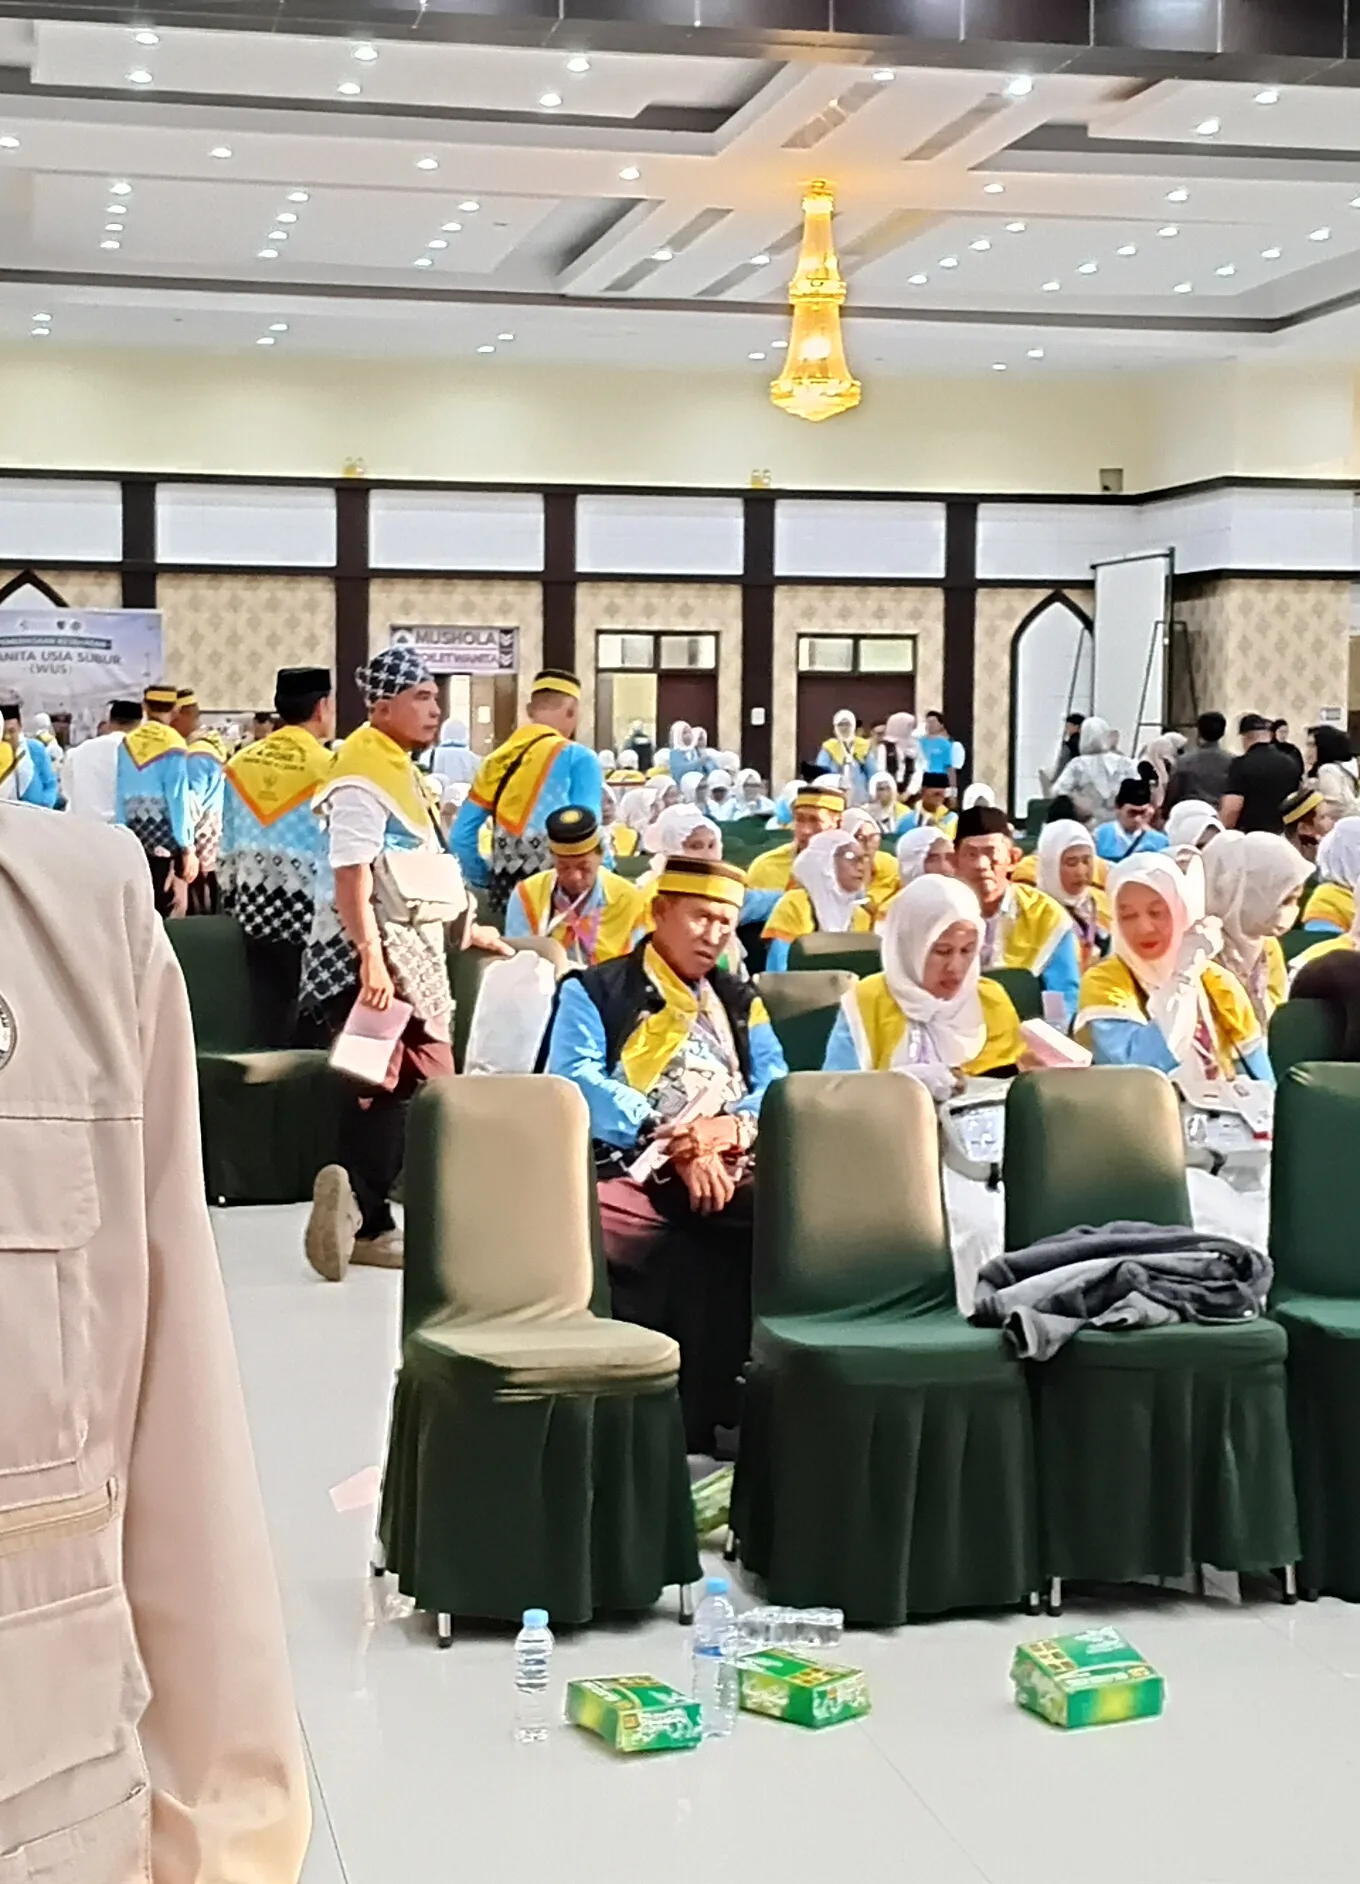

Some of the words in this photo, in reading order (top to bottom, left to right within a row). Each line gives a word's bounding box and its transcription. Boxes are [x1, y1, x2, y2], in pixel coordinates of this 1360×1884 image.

[415, 630, 497, 645] MUSHOLA
[41, 651, 73, 663] USIA
[77, 652, 121, 665] SUBUR
